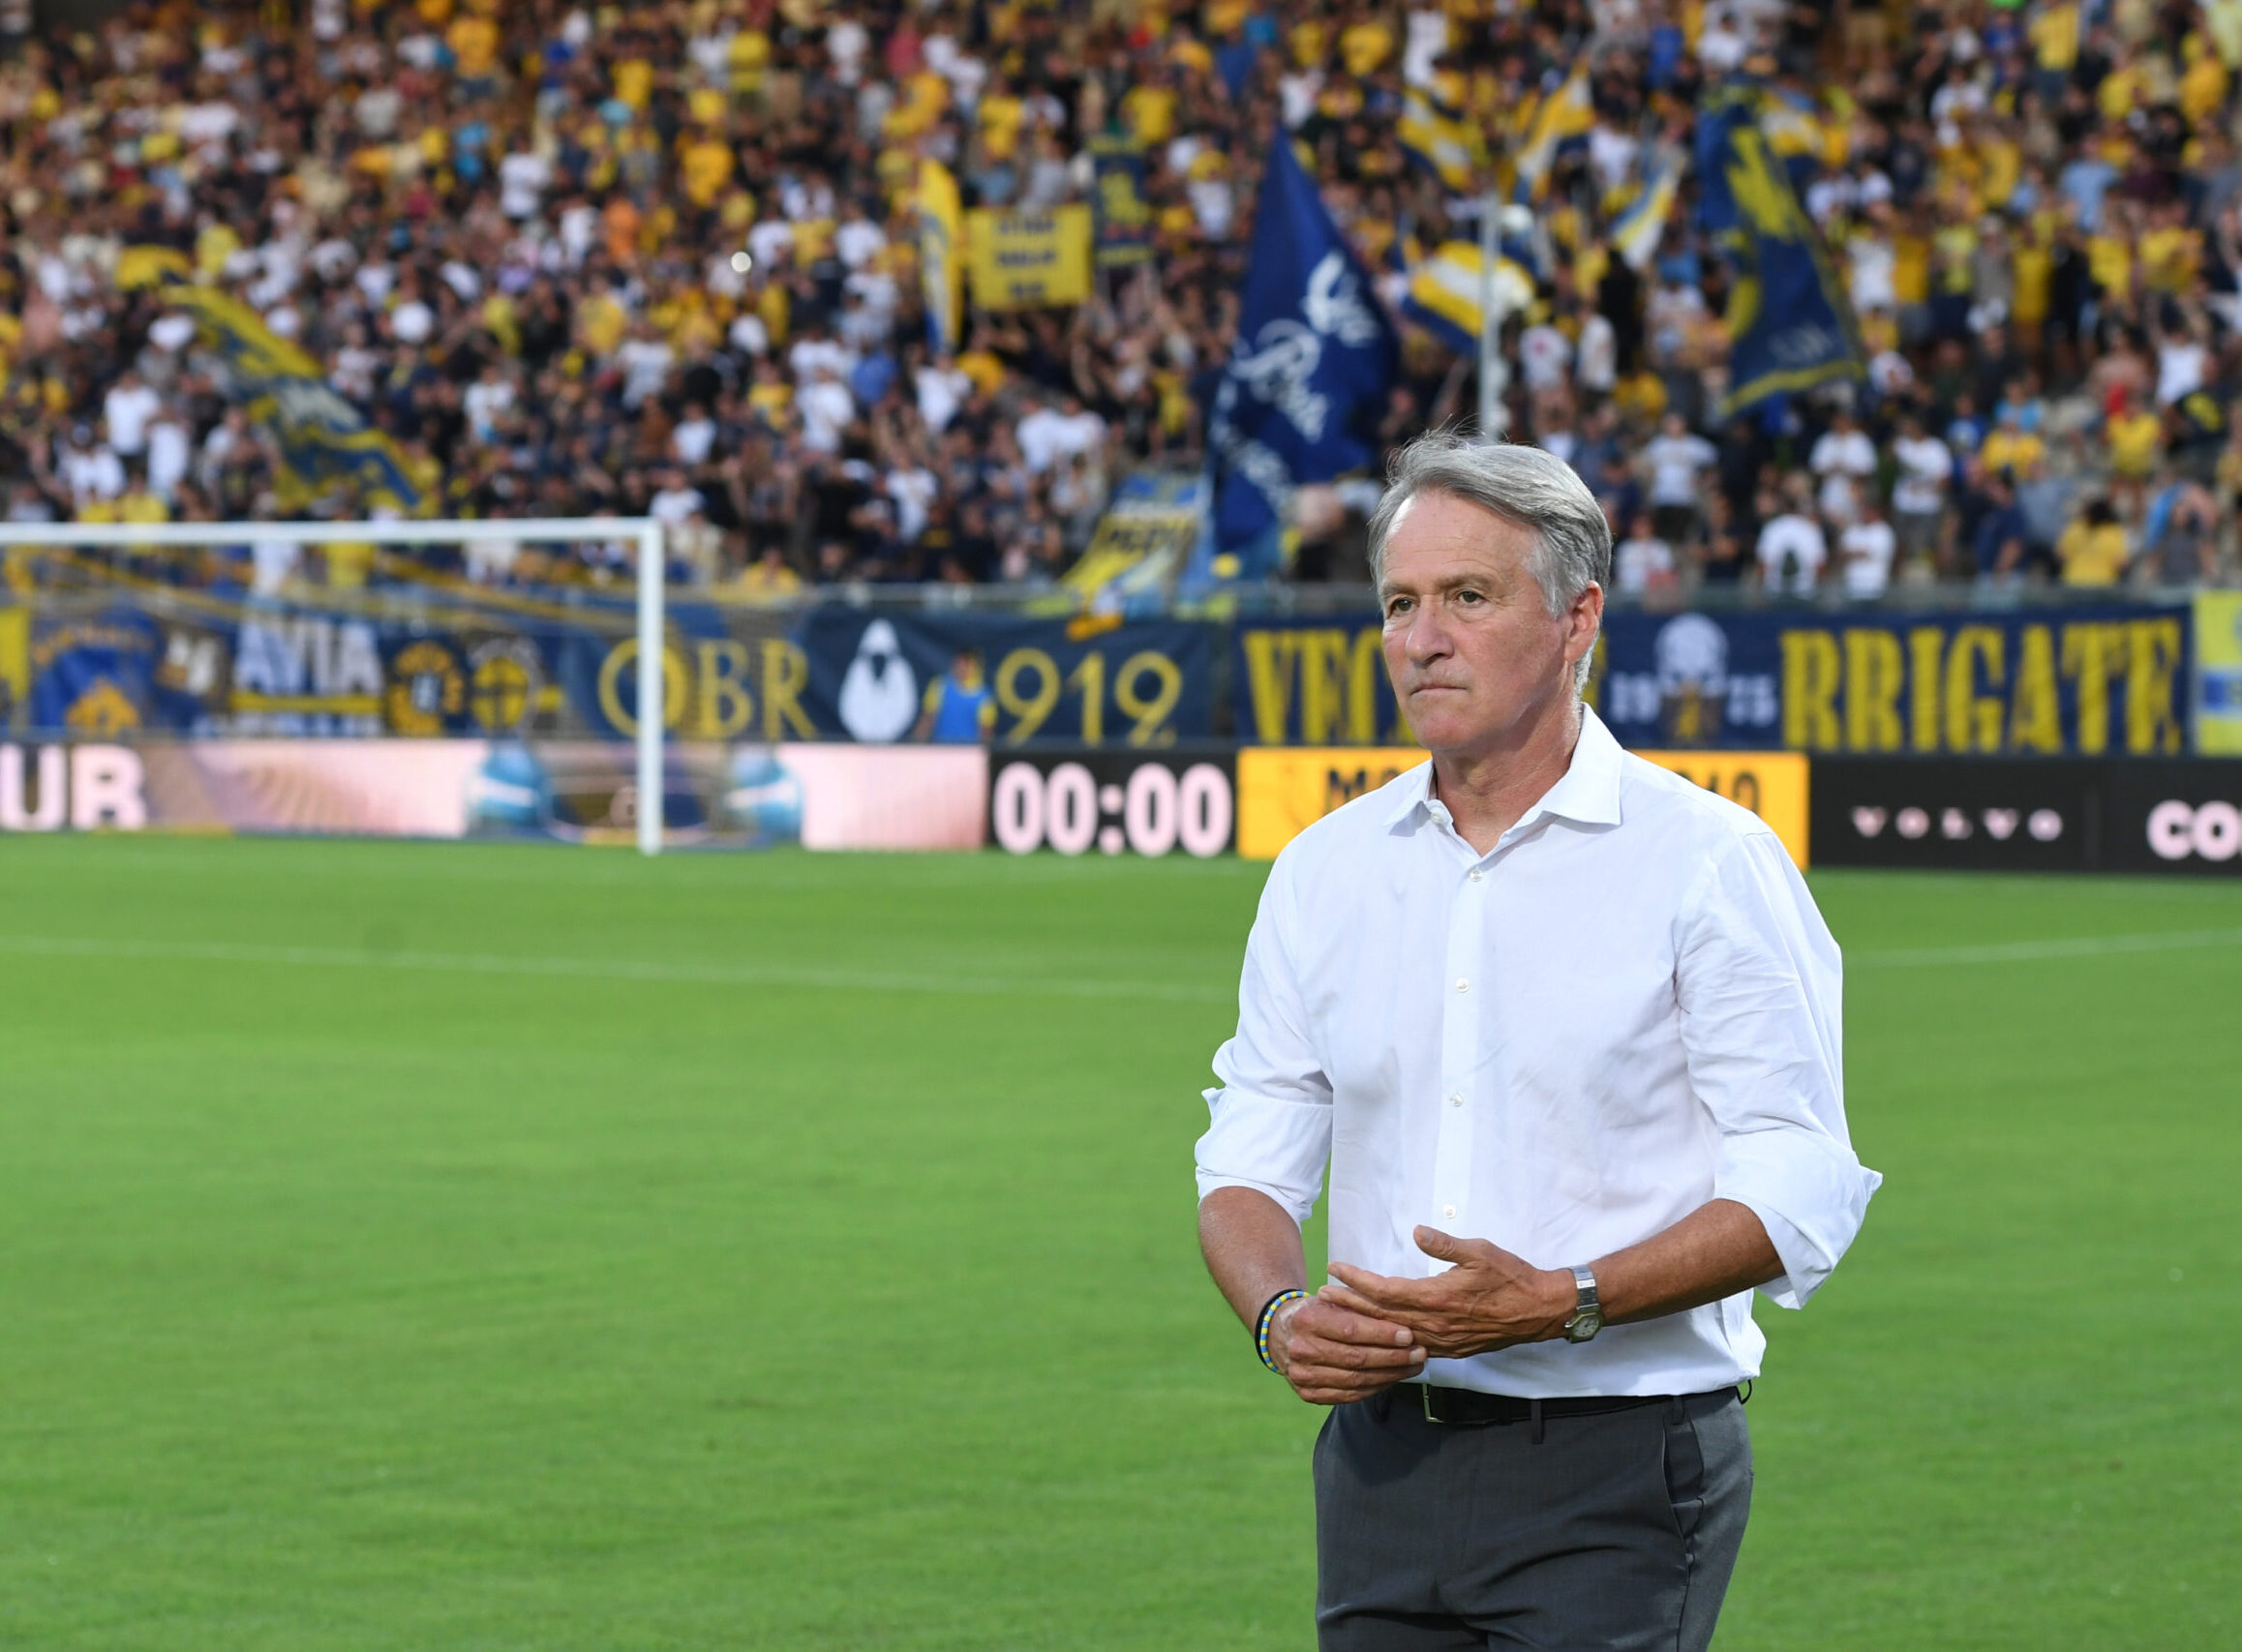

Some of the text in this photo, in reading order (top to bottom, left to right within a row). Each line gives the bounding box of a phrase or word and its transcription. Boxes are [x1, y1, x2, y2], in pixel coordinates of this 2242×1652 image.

[992, 762, 1232, 856] 00:00
[1850, 805, 2064, 841] VOLVO
[2145, 798, 2242, 862] CO
